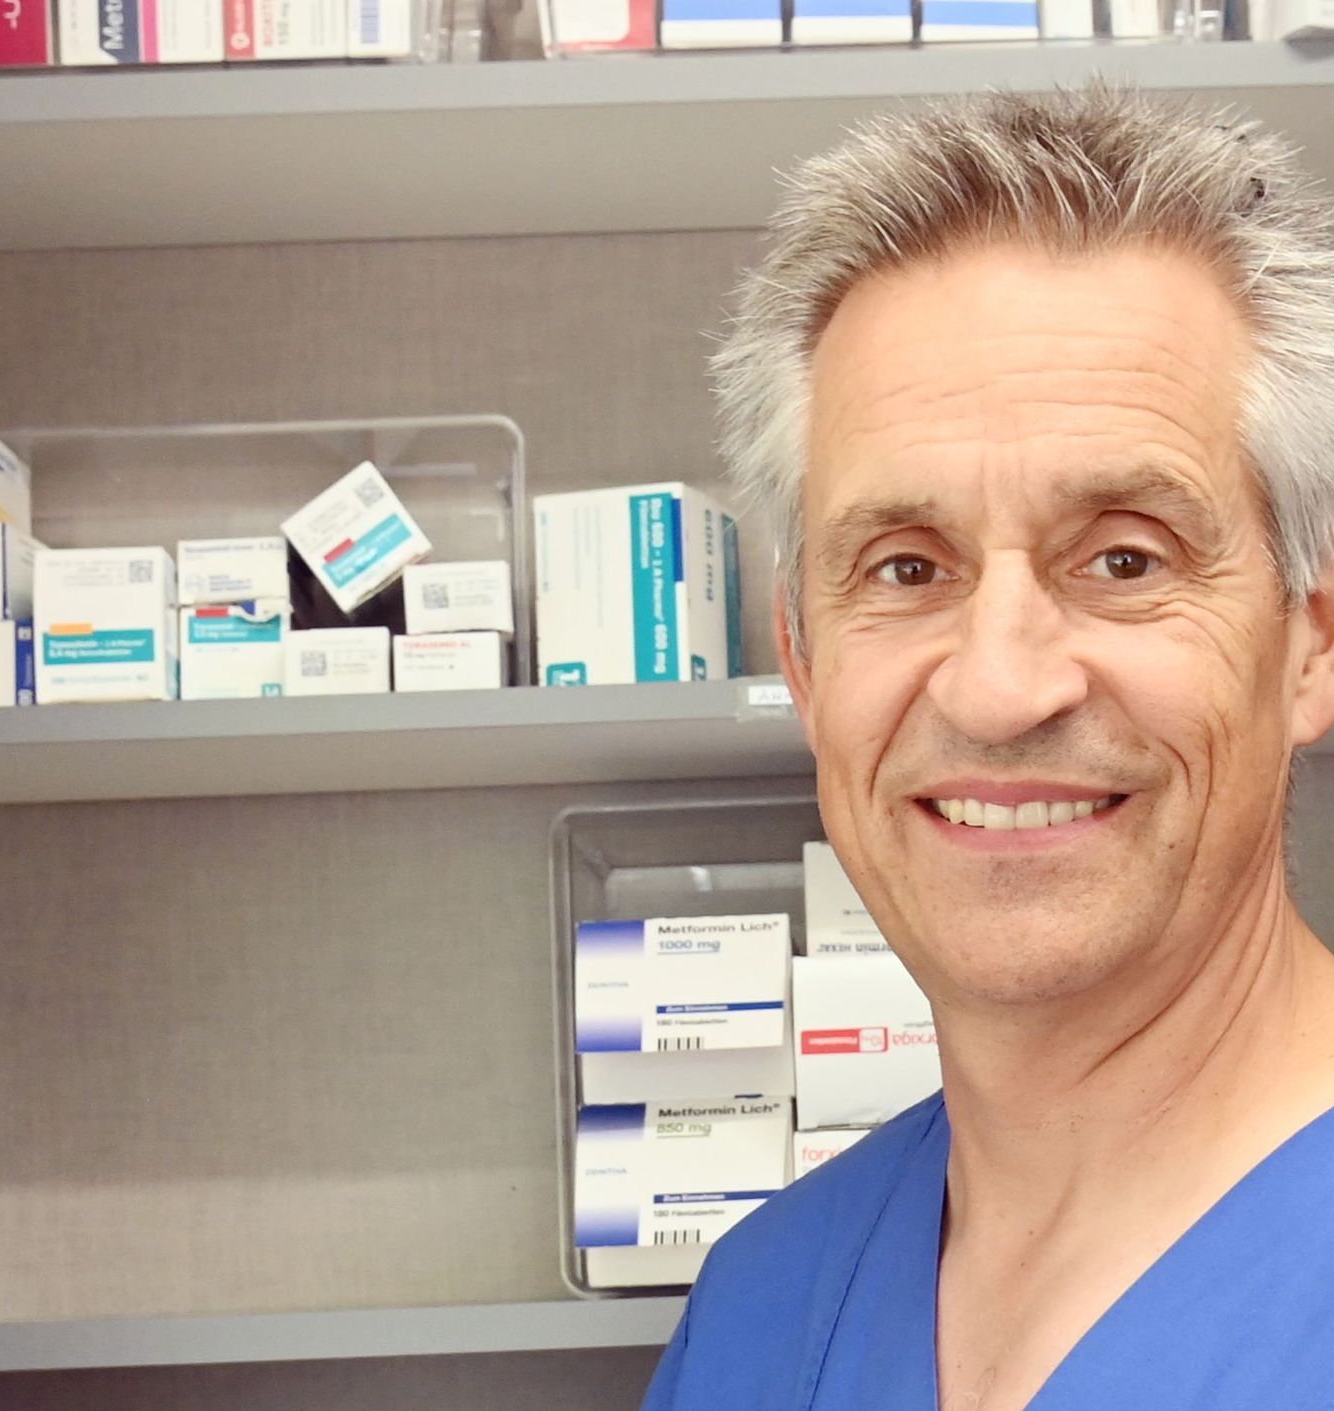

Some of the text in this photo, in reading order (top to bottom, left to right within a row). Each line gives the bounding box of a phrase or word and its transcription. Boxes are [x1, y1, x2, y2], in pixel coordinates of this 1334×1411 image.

[657, 923, 737, 936] Metformin
[657, 939, 721, 952] 1000 mg
[657, 1105, 737, 1118] Metformin
[656, 1122, 712, 1135] 850 mg
